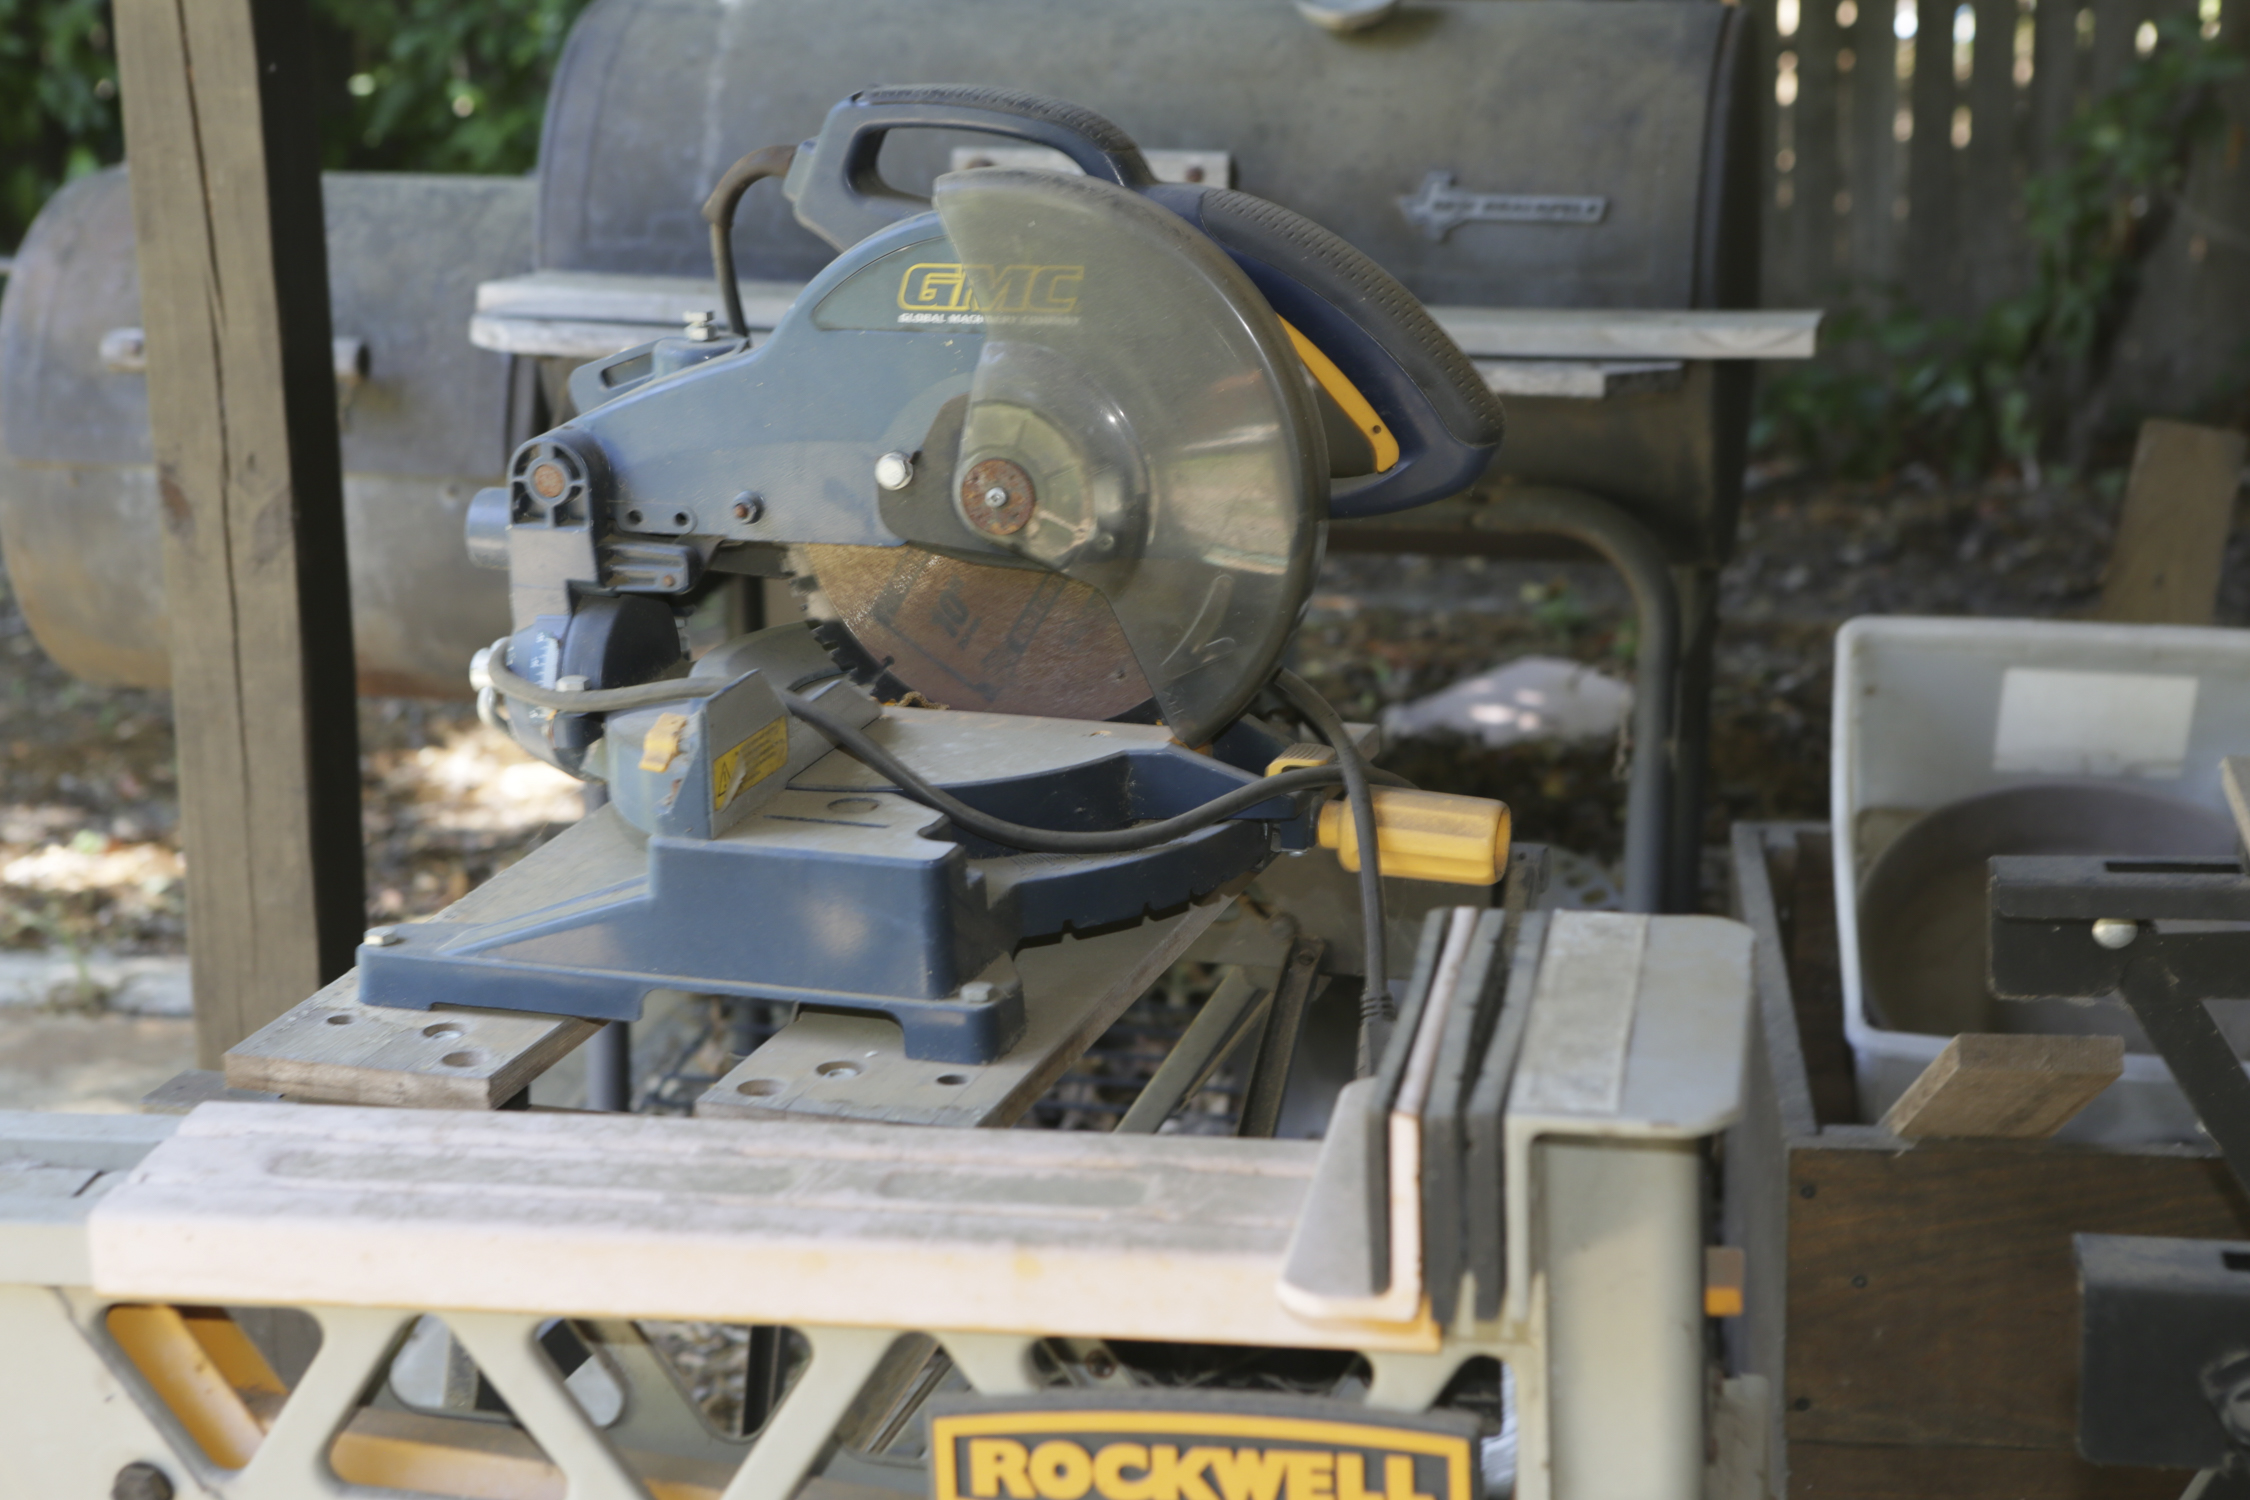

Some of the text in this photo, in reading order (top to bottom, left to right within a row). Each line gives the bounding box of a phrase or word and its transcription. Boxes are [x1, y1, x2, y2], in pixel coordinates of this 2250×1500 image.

[897, 262, 1085, 312] GMC
[897, 312, 946, 324] GLOBAL
[968, 1437, 1436, 1500] ROCKWELL
